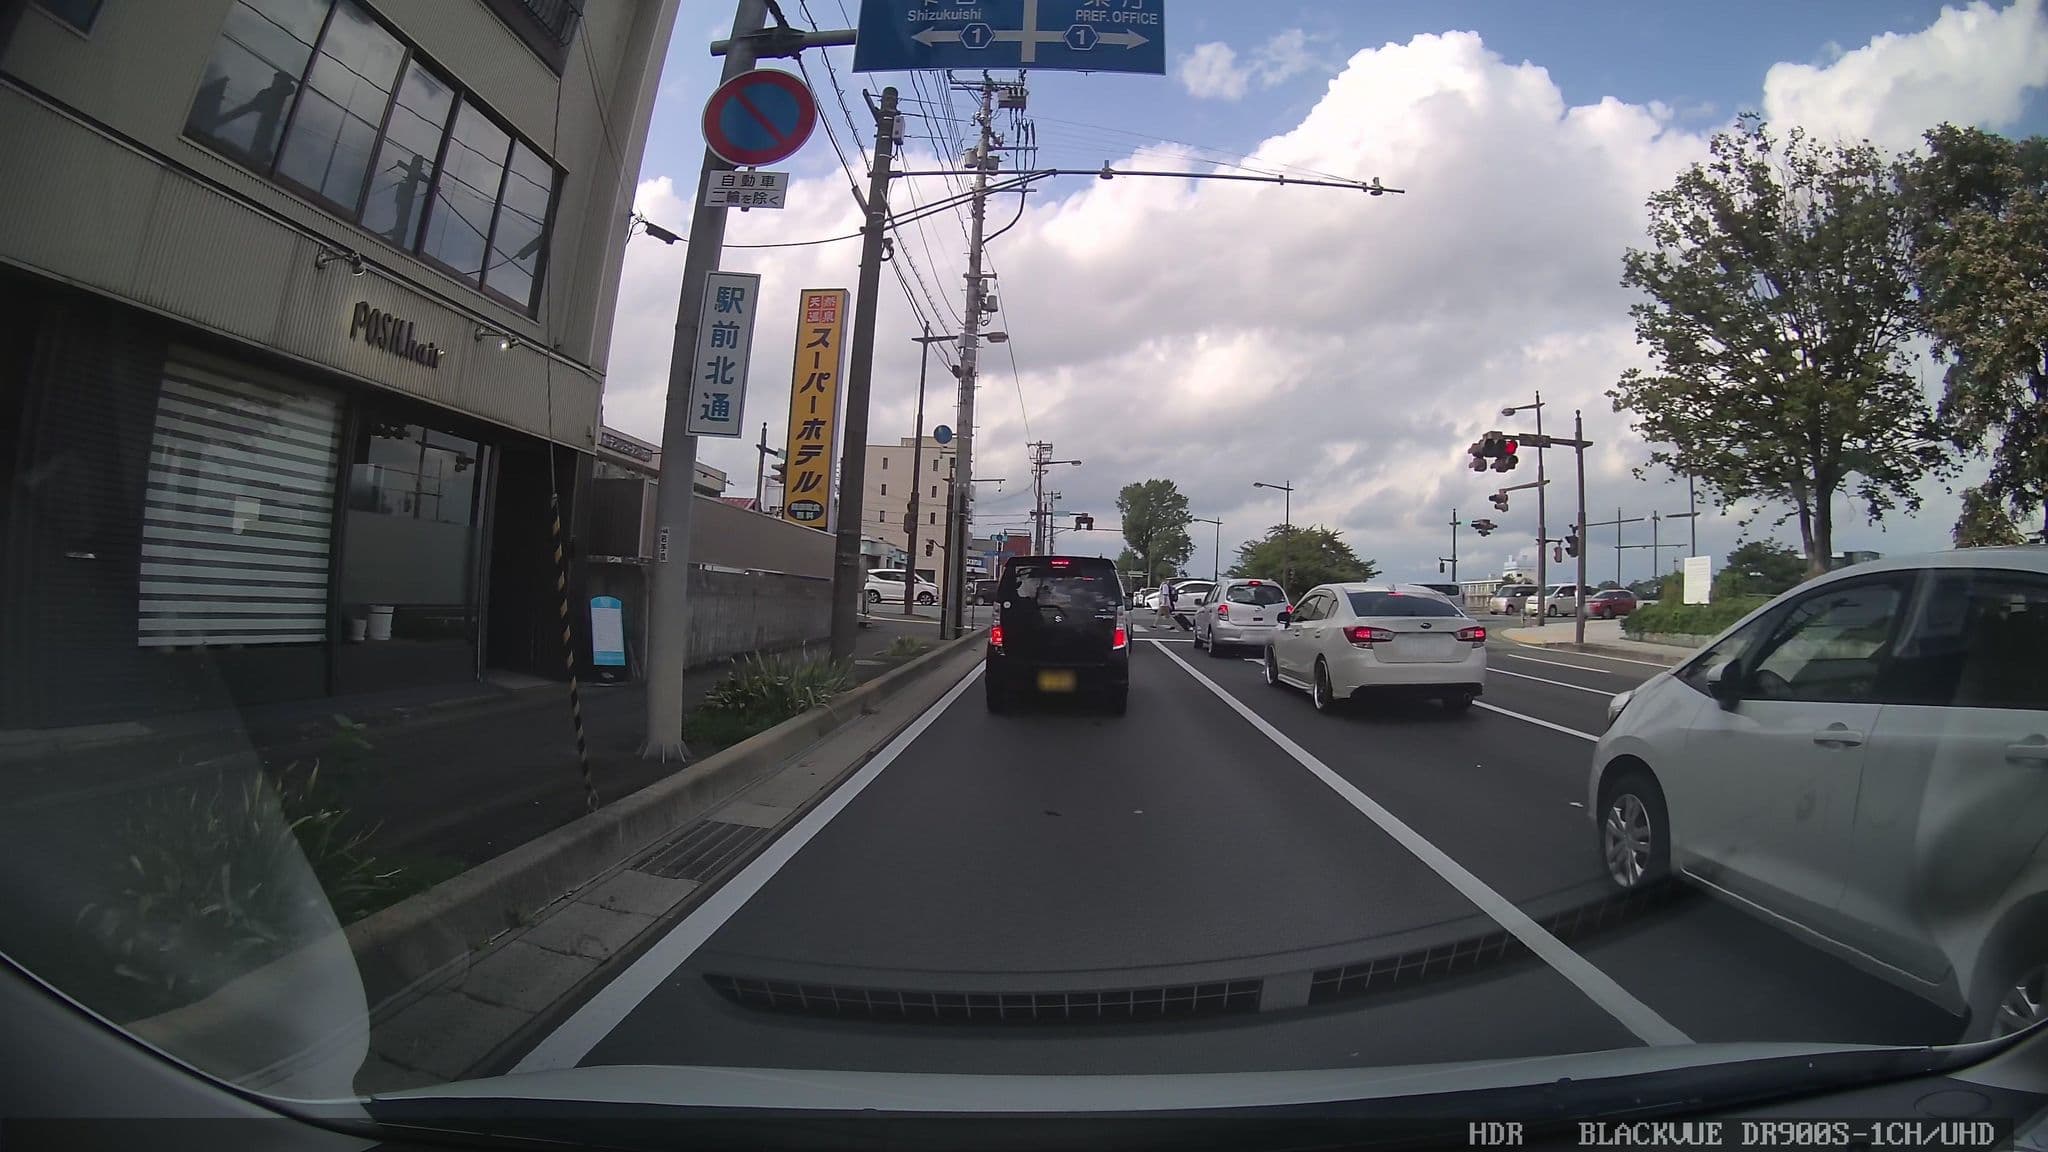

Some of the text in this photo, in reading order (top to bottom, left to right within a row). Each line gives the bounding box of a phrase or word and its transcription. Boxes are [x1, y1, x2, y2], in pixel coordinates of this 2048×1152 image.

[907, 8, 982, 21] Shizukuishi
[1076, 9, 1158, 24] PREF. OFFICE
[971, 28, 981, 43] 1
[1076, 29, 1086, 45] 1
[721, 174, 776, 188] 自動車
[710, 190, 779, 205] 二輪を除く
[700, 286, 746, 422] 駅前北通
[791, 327, 832, 493] スーパーホテル
